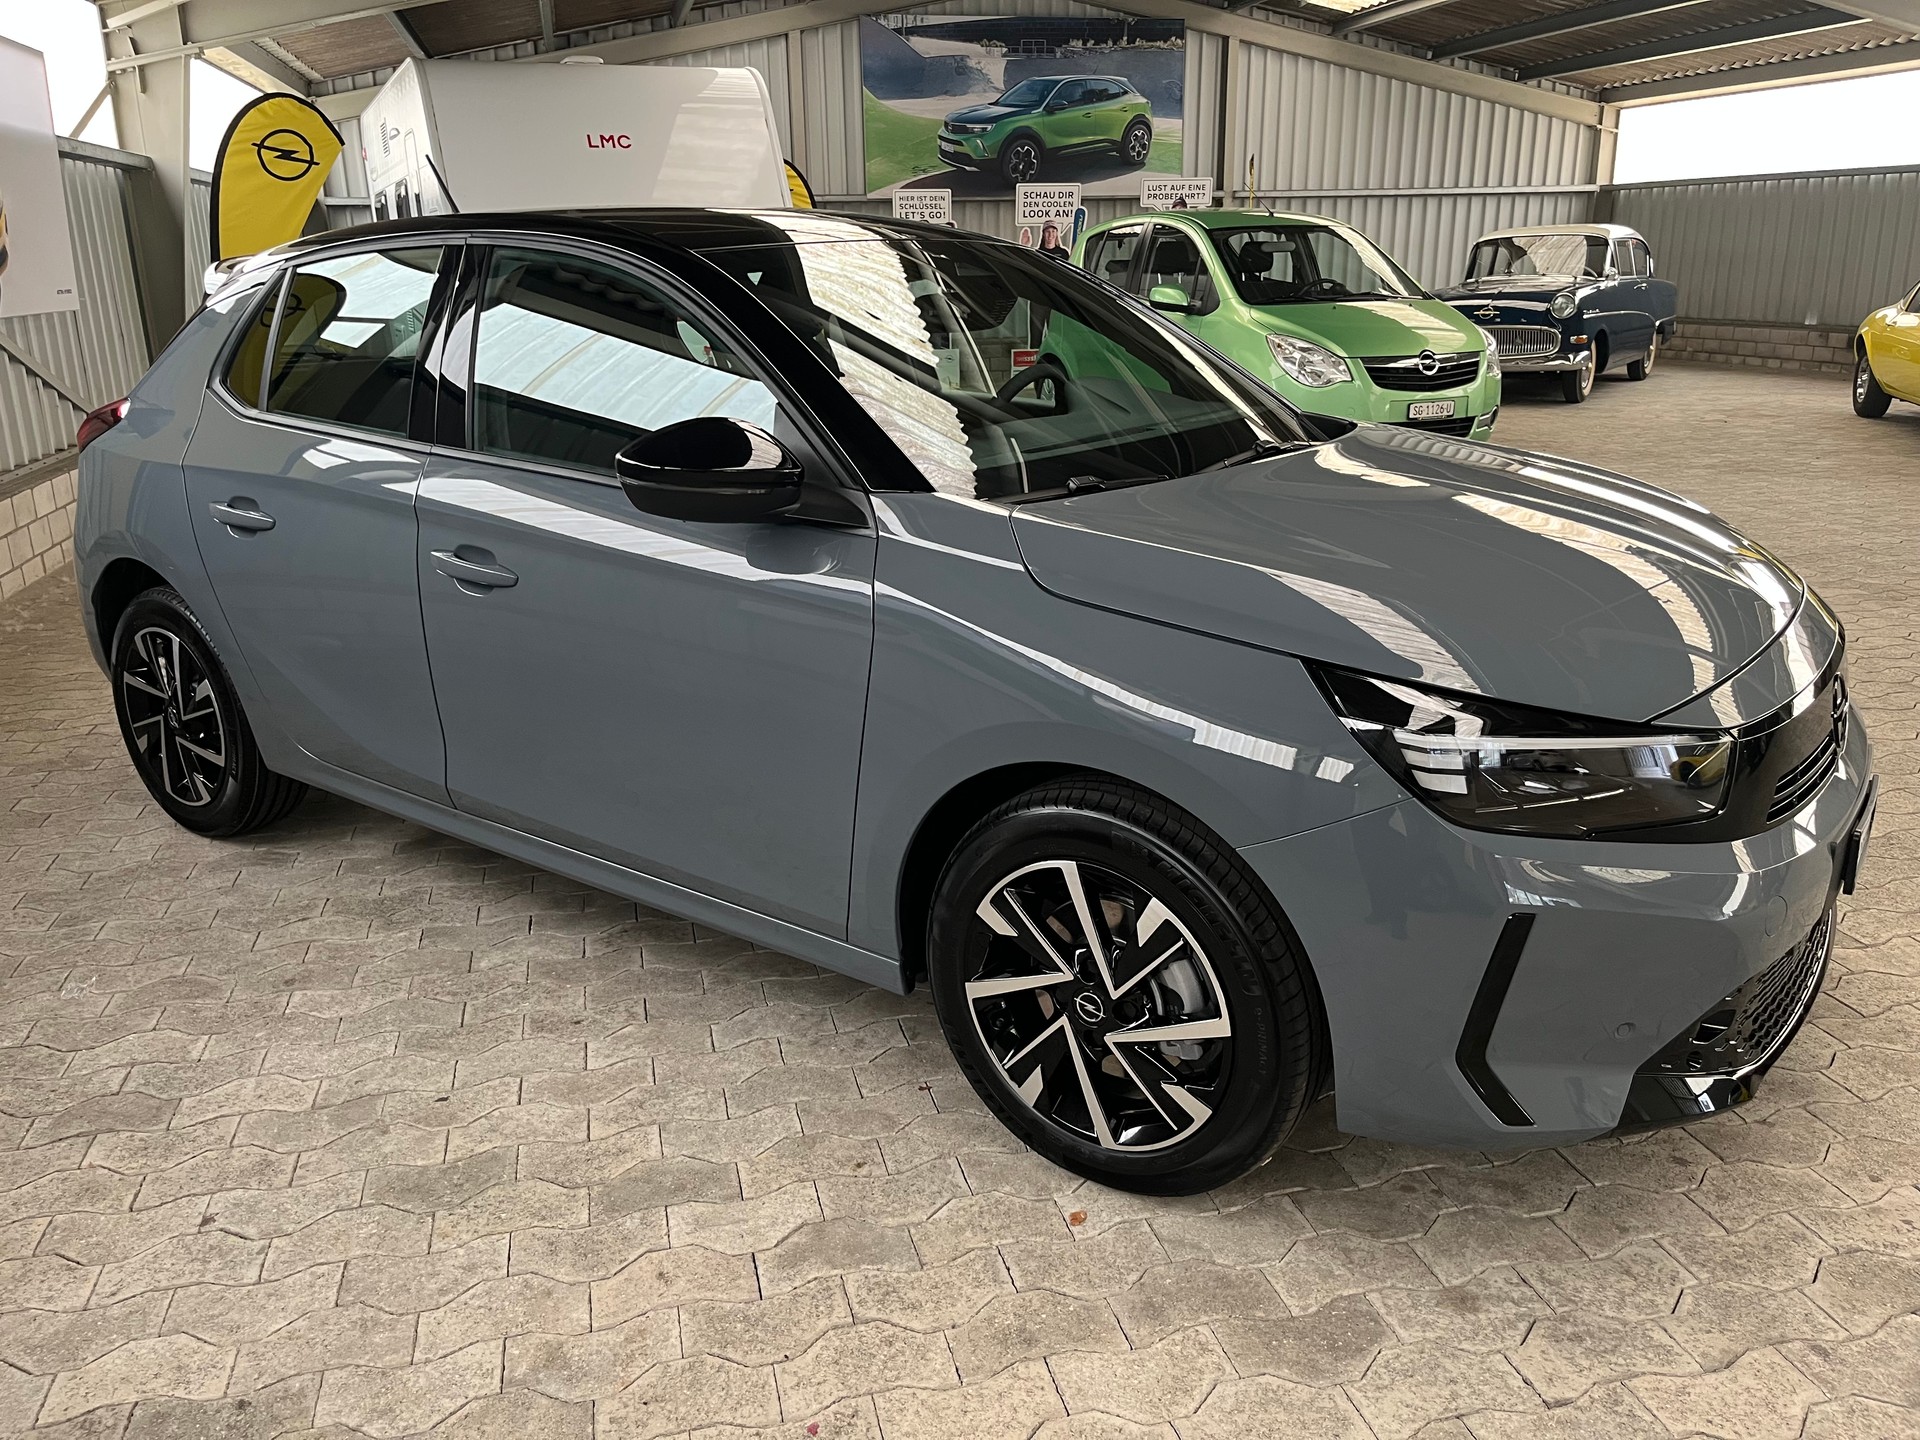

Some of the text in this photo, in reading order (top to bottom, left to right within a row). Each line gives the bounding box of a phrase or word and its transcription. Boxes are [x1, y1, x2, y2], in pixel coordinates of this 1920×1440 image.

[586, 134, 632, 149] LMC
[1147, 184, 1168, 192] LUST
[1023, 191, 1074, 200] SCHAU DIR
[1147, 192, 1206, 201] PROBEFAHRT?
[899, 202, 946, 210] SCHLÜSSEL.
[1041, 200, 1074, 208] COOLEN
[899, 211, 946, 219] LET'S GO!
[1023, 209, 1073, 218] LOOK AN!
